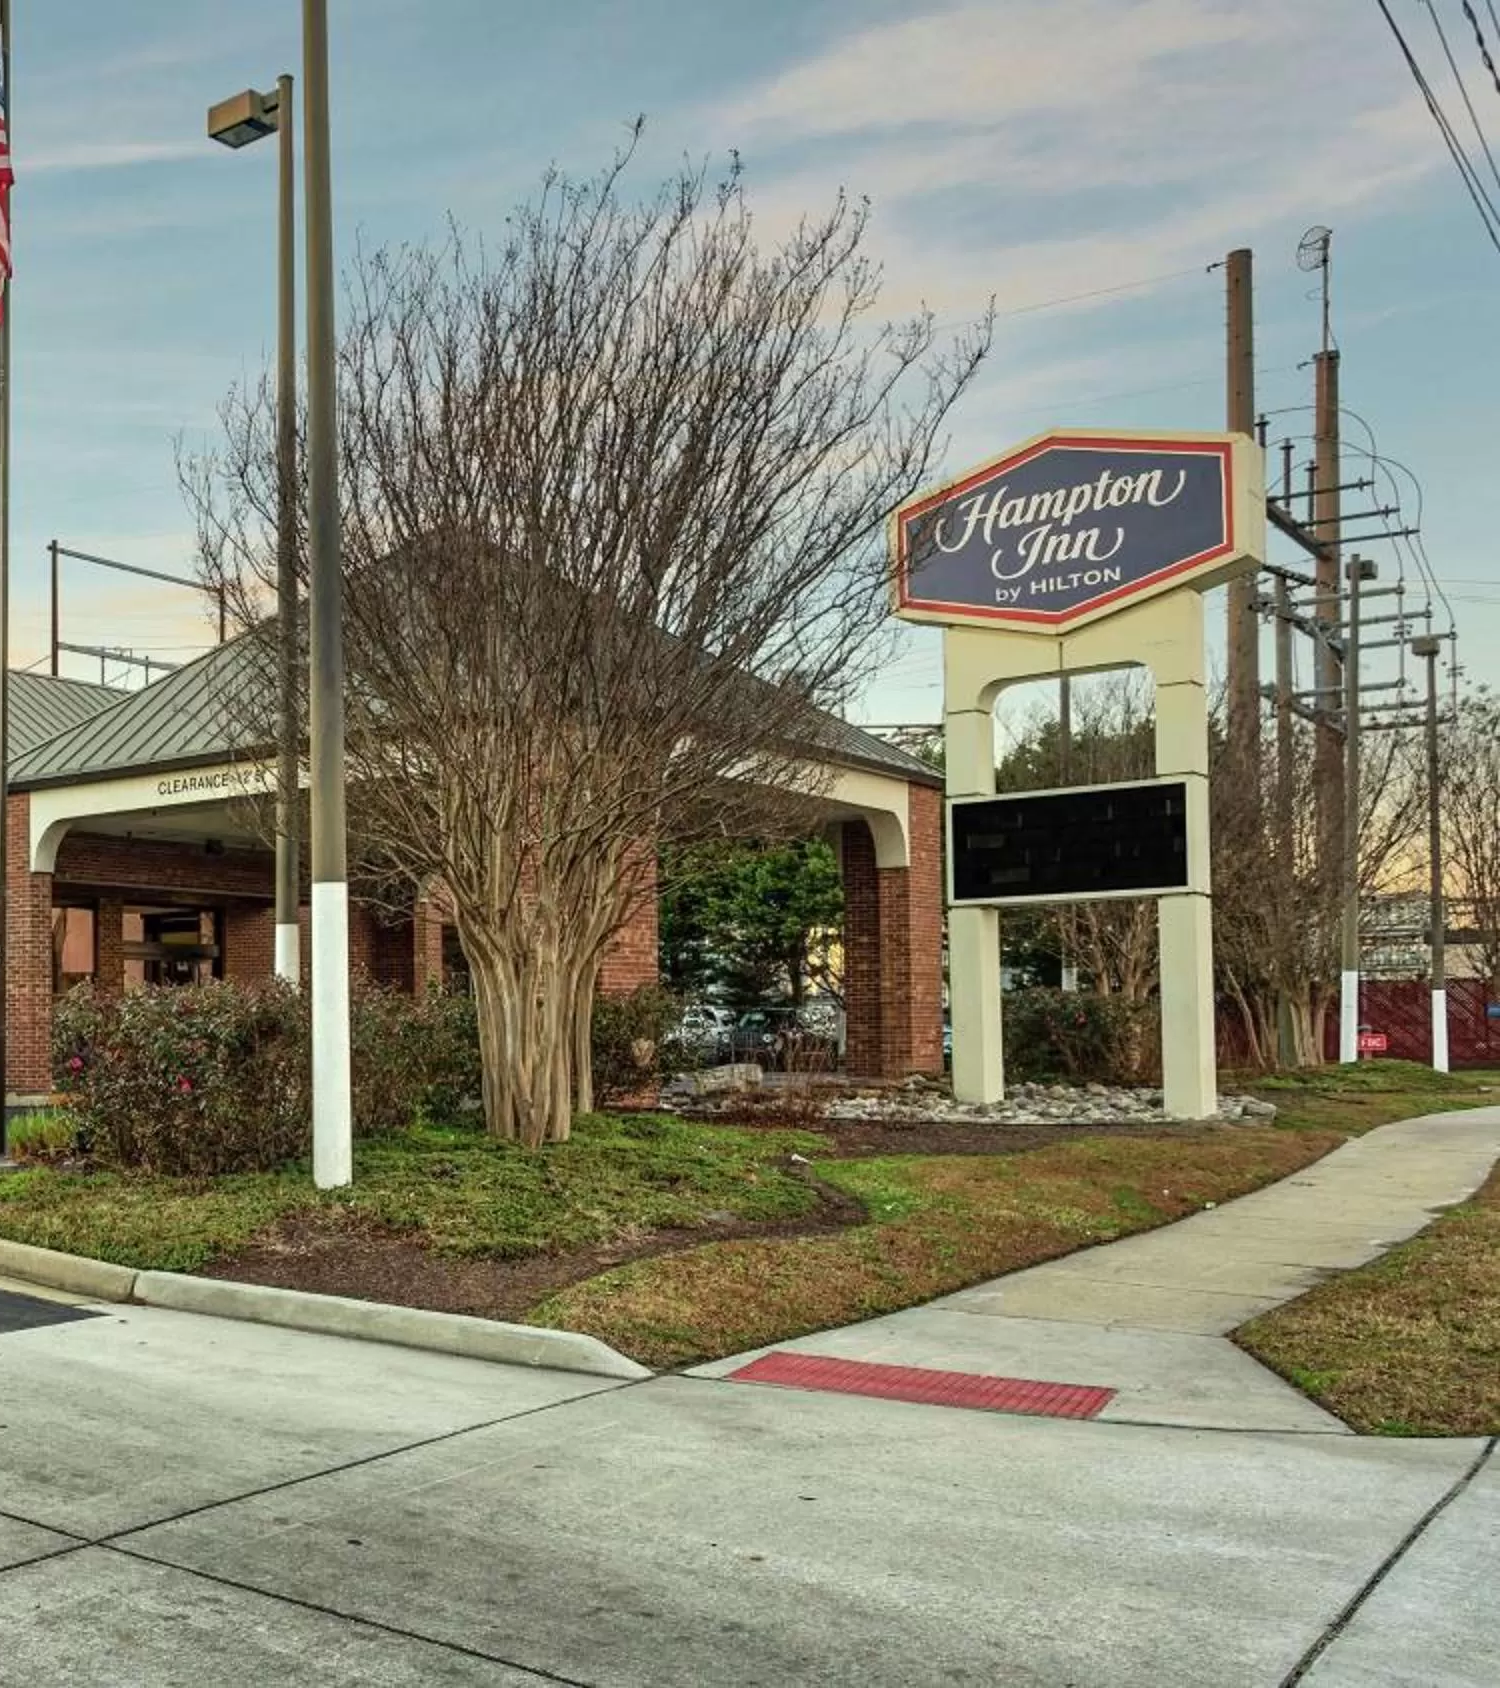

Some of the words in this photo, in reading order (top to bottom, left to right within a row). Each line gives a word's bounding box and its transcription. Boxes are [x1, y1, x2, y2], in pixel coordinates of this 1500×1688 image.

[935, 469, 1187, 553] Hampton
[991, 525, 1124, 581] Inn
[994, 588, 1021, 603] by
[1030, 566, 1122, 596] HILTON
[157, 772, 229, 795] CLEARANCE
